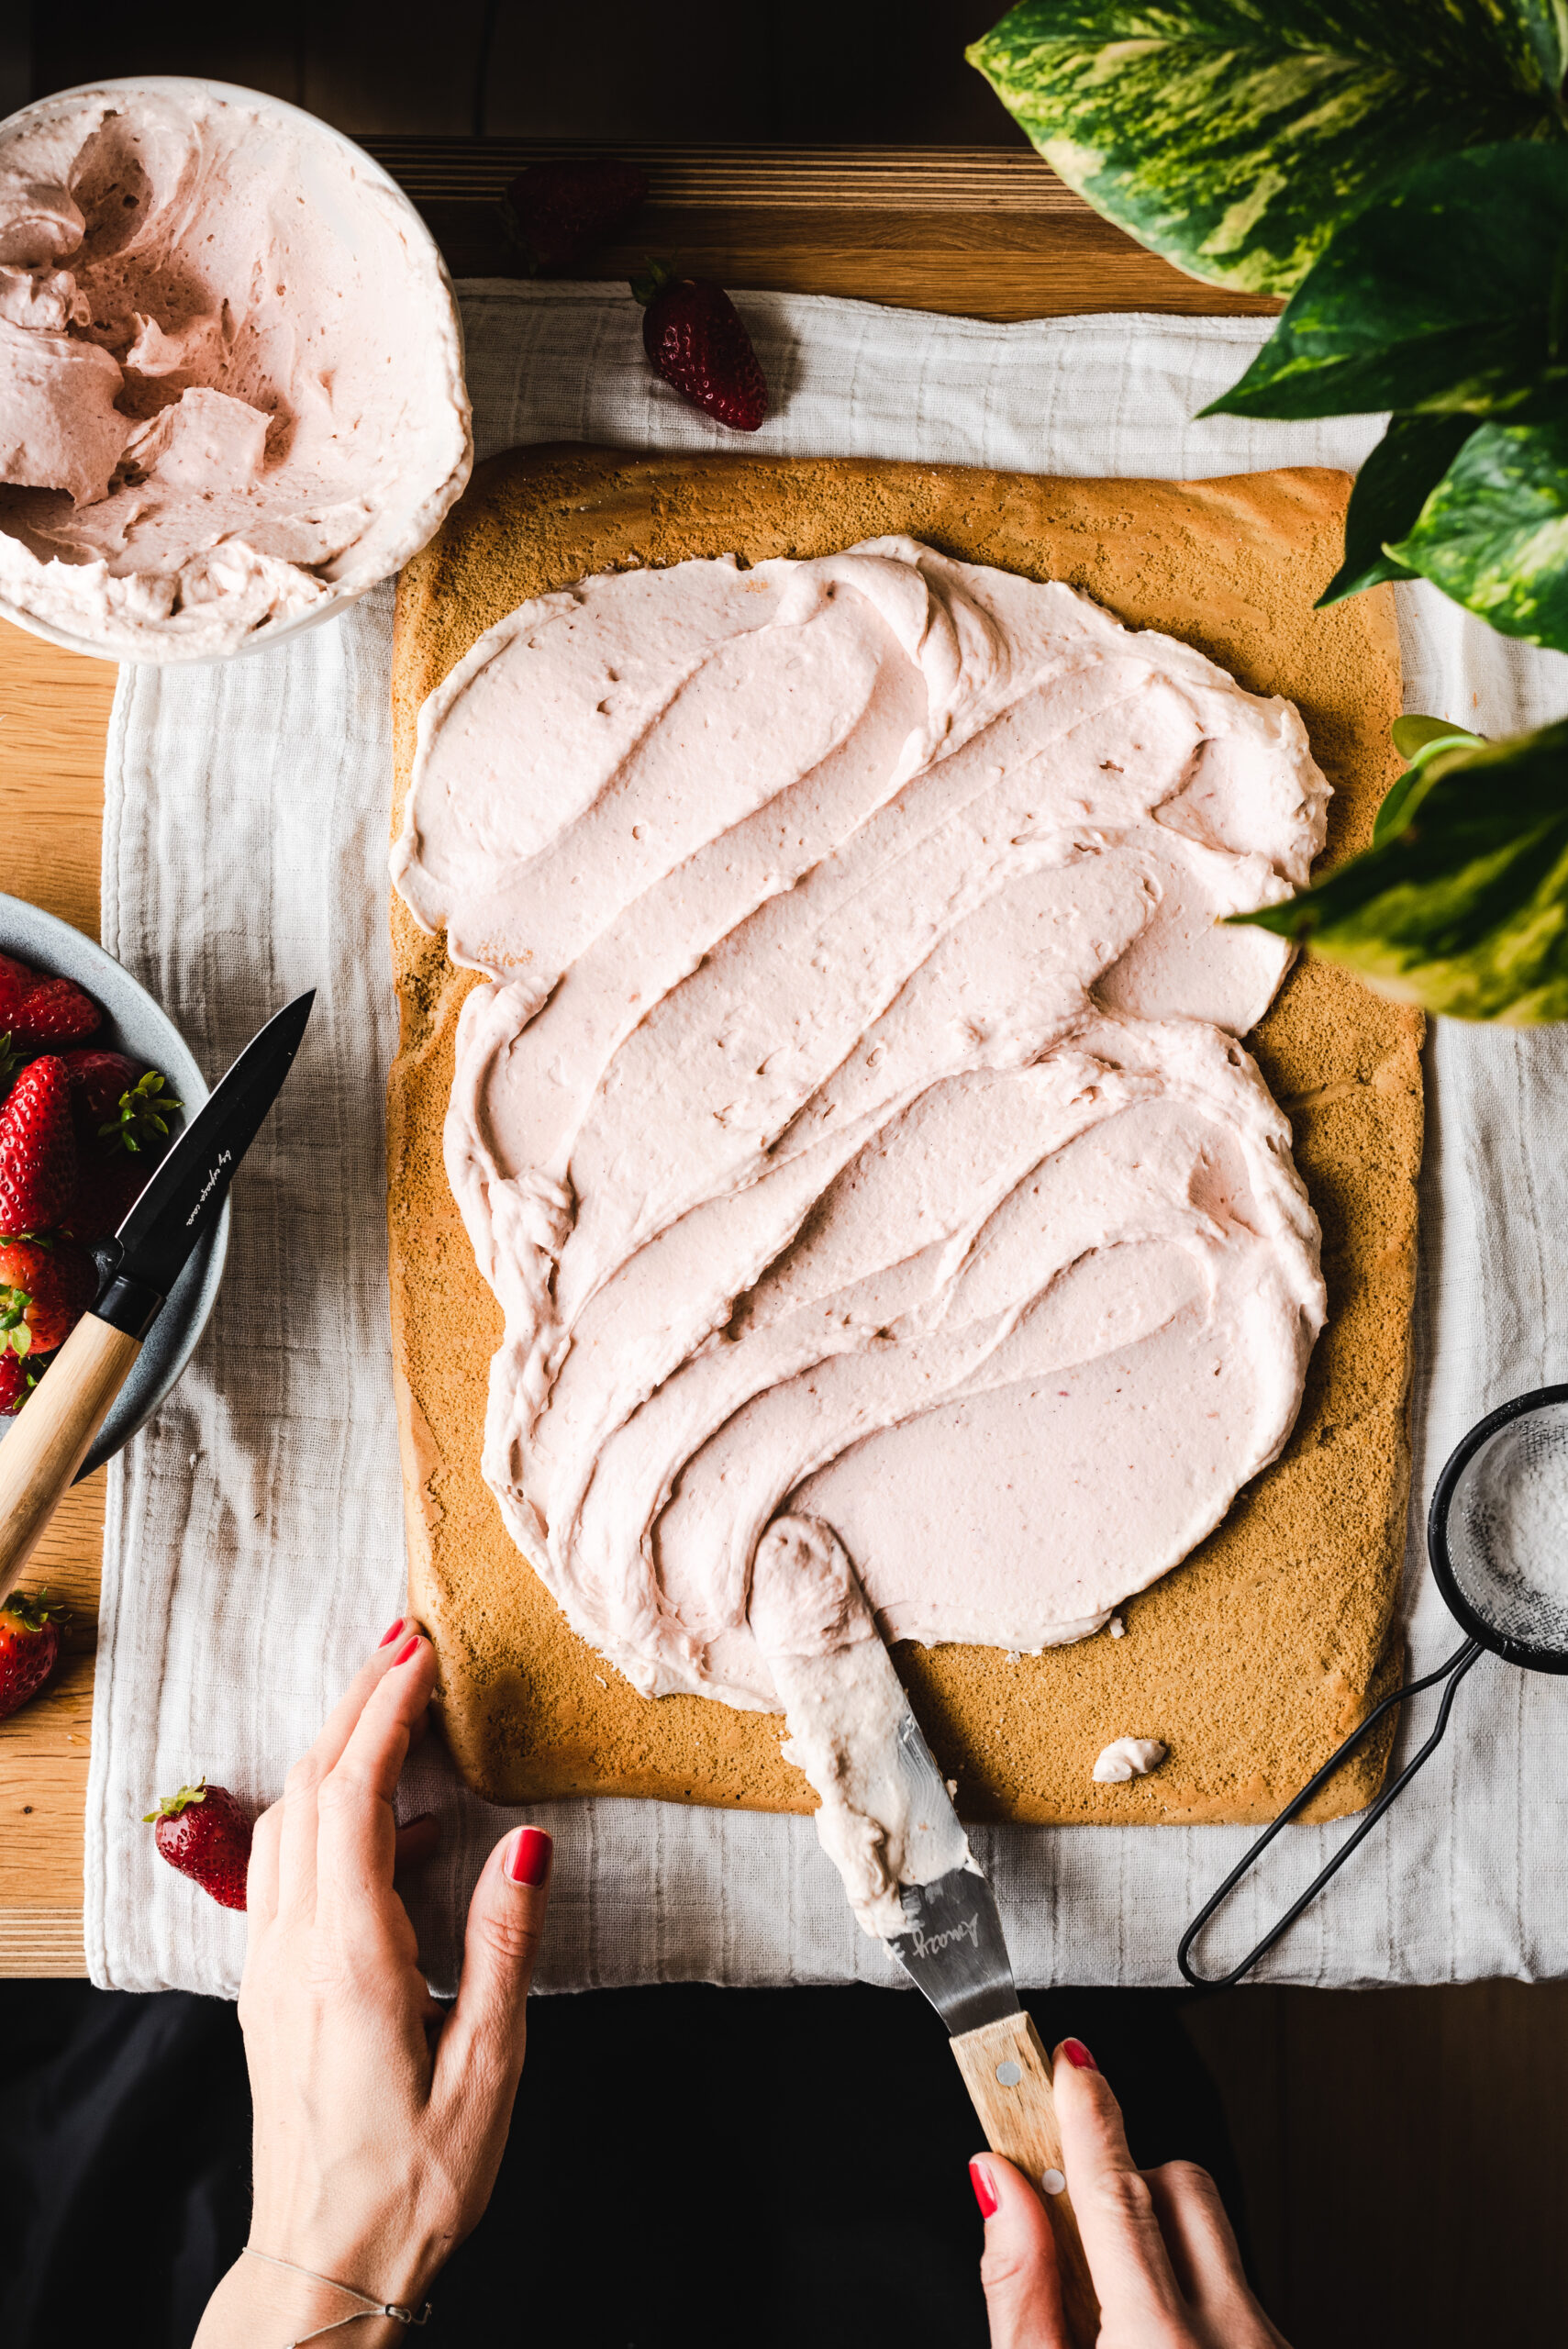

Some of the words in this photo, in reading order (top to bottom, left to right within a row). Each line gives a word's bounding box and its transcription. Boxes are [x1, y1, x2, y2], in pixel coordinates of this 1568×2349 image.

[218, 1150, 231, 1166] by
[186, 1204, 200, 1226] casa
[912, 1912, 979, 1959] Amazy
